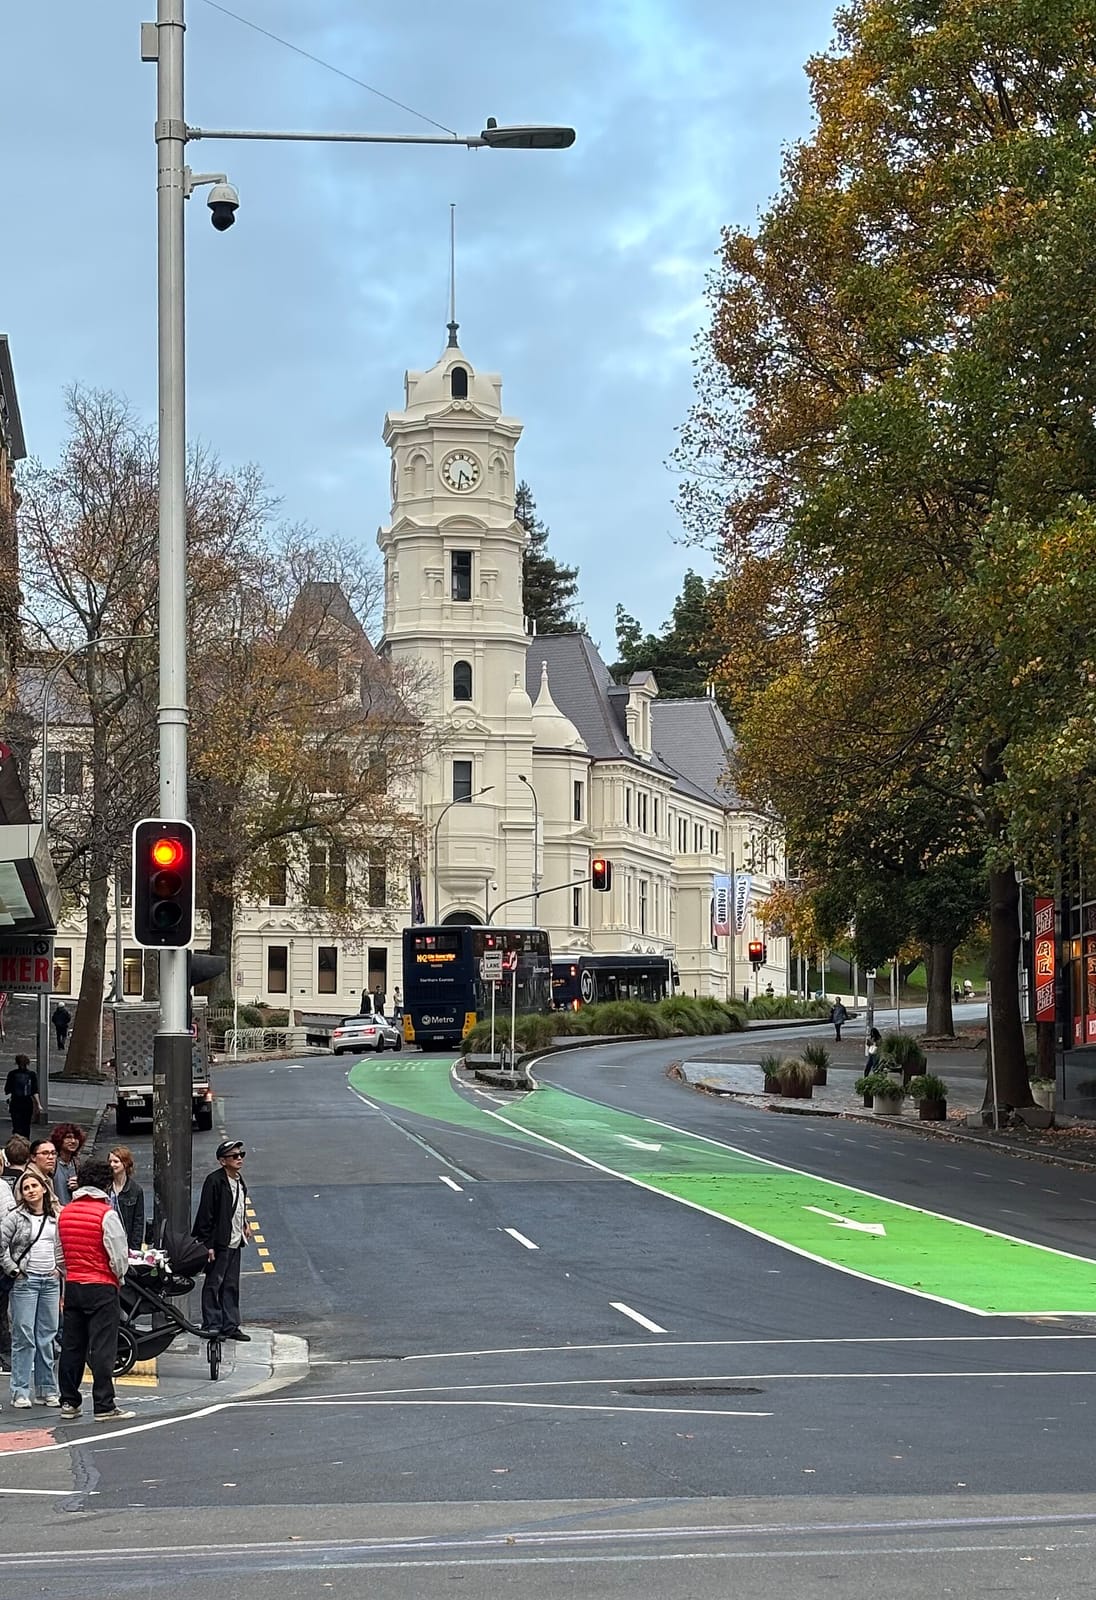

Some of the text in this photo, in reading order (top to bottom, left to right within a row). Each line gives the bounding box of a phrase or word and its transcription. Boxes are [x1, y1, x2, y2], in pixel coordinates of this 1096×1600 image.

[717, 888, 727, 923] FOREVER
[1036, 907, 1053, 925] BEST
[1036, 918, 1053, 935] CHEF
[1037, 982, 1055, 1000] BEST
[1037, 992, 1055, 1010] CHEF
[432, 1016, 455, 1024] Metro
